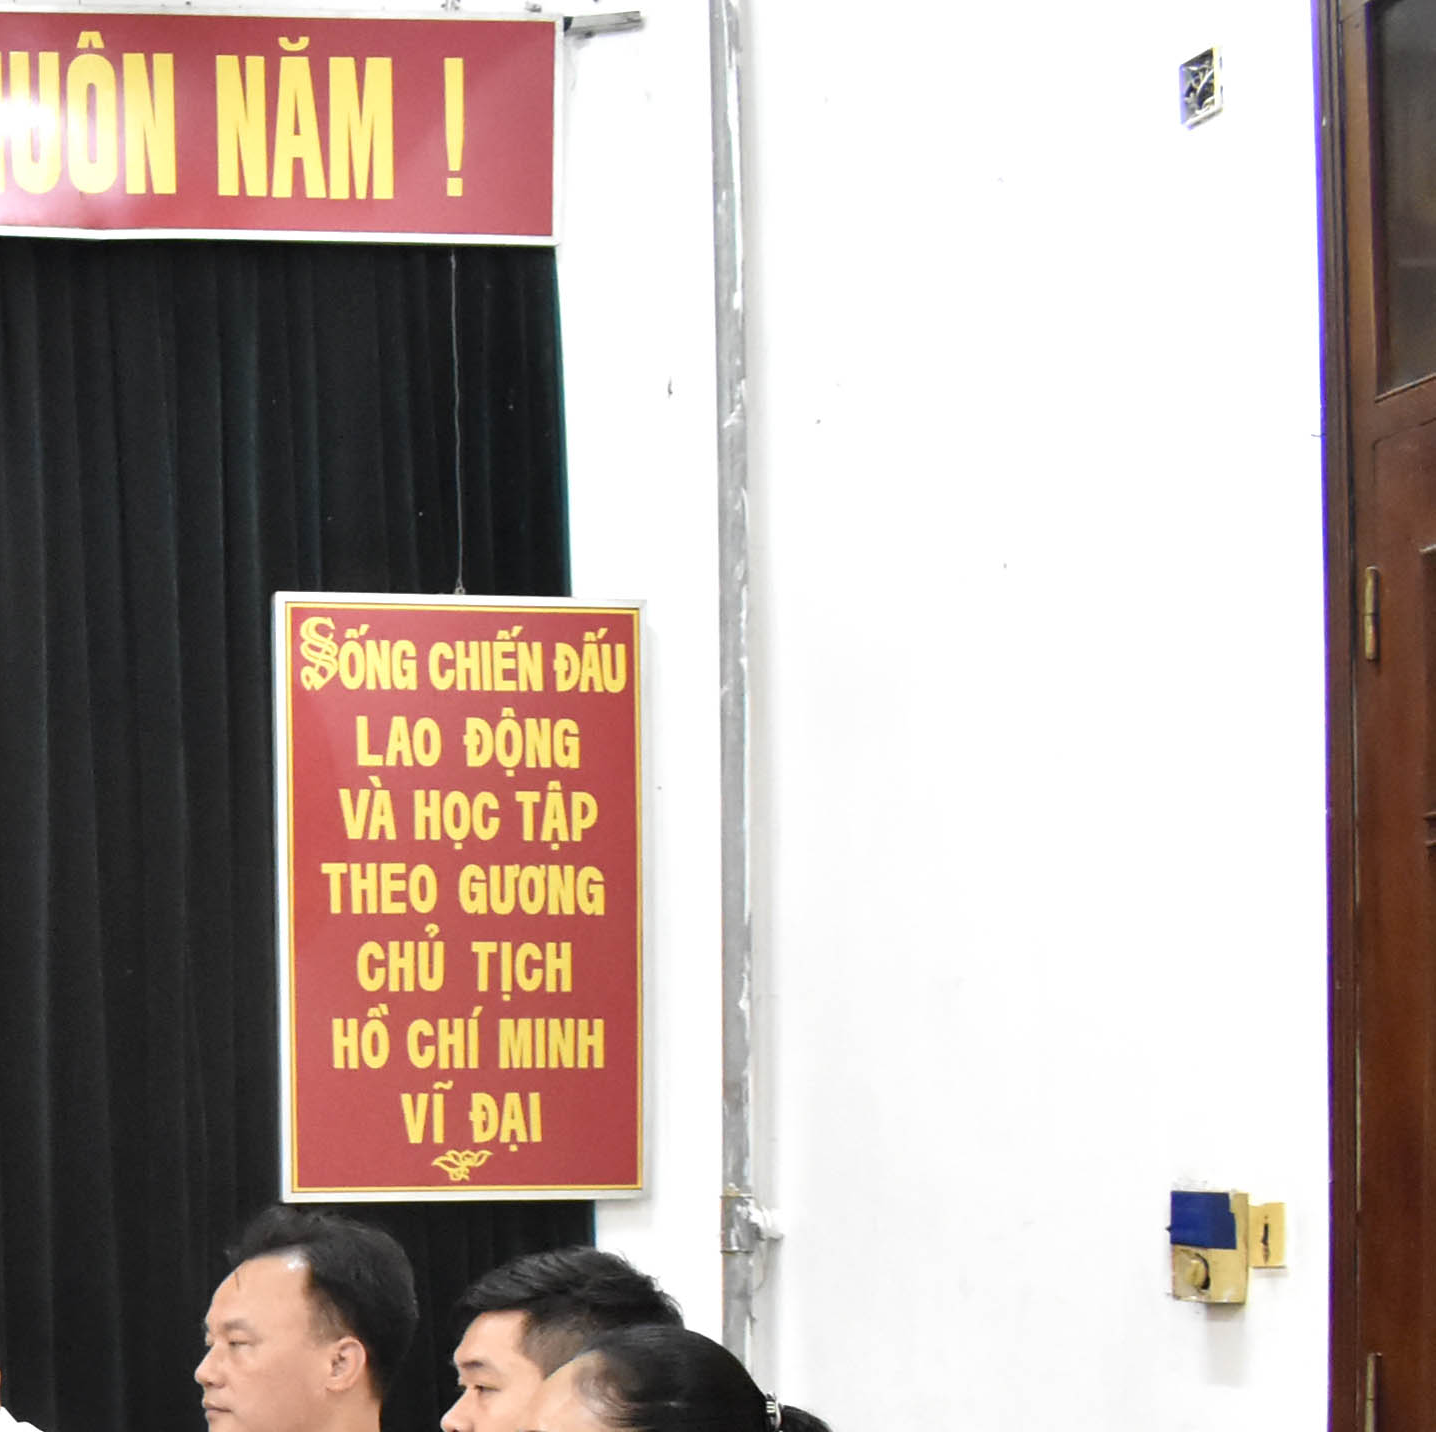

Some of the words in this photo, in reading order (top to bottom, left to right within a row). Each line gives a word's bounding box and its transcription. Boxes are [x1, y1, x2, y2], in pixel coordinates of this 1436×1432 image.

[215, 36, 395, 200] NĂM
[444, 57, 465, 196] !
[300, 616, 419, 691] SỐNG
[429, 626, 544, 692] CHIẾN
[553, 628, 627, 693] ĐẤU
[356, 715, 442, 768] LAO
[463, 708, 580, 777] ĐỘNG
[339, 776, 397, 841] VÀ
[414, 789, 501, 850] HỌC
[515, 781, 598, 850] TẬP
[321, 863, 438, 915] THEO
[459, 863, 605, 916] GƯƠNG
[357, 923, 445, 993] CHỦ
[471, 942, 572, 1001] TỊCH
[332, 1004, 390, 1069] HỒ
[407, 1006, 483, 1070] CHÍ
[499, 1018, 605, 1069] MINH
[401, 1080, 455, 1144] VĨ
[470, 1092, 542, 1152] ĐẠI
